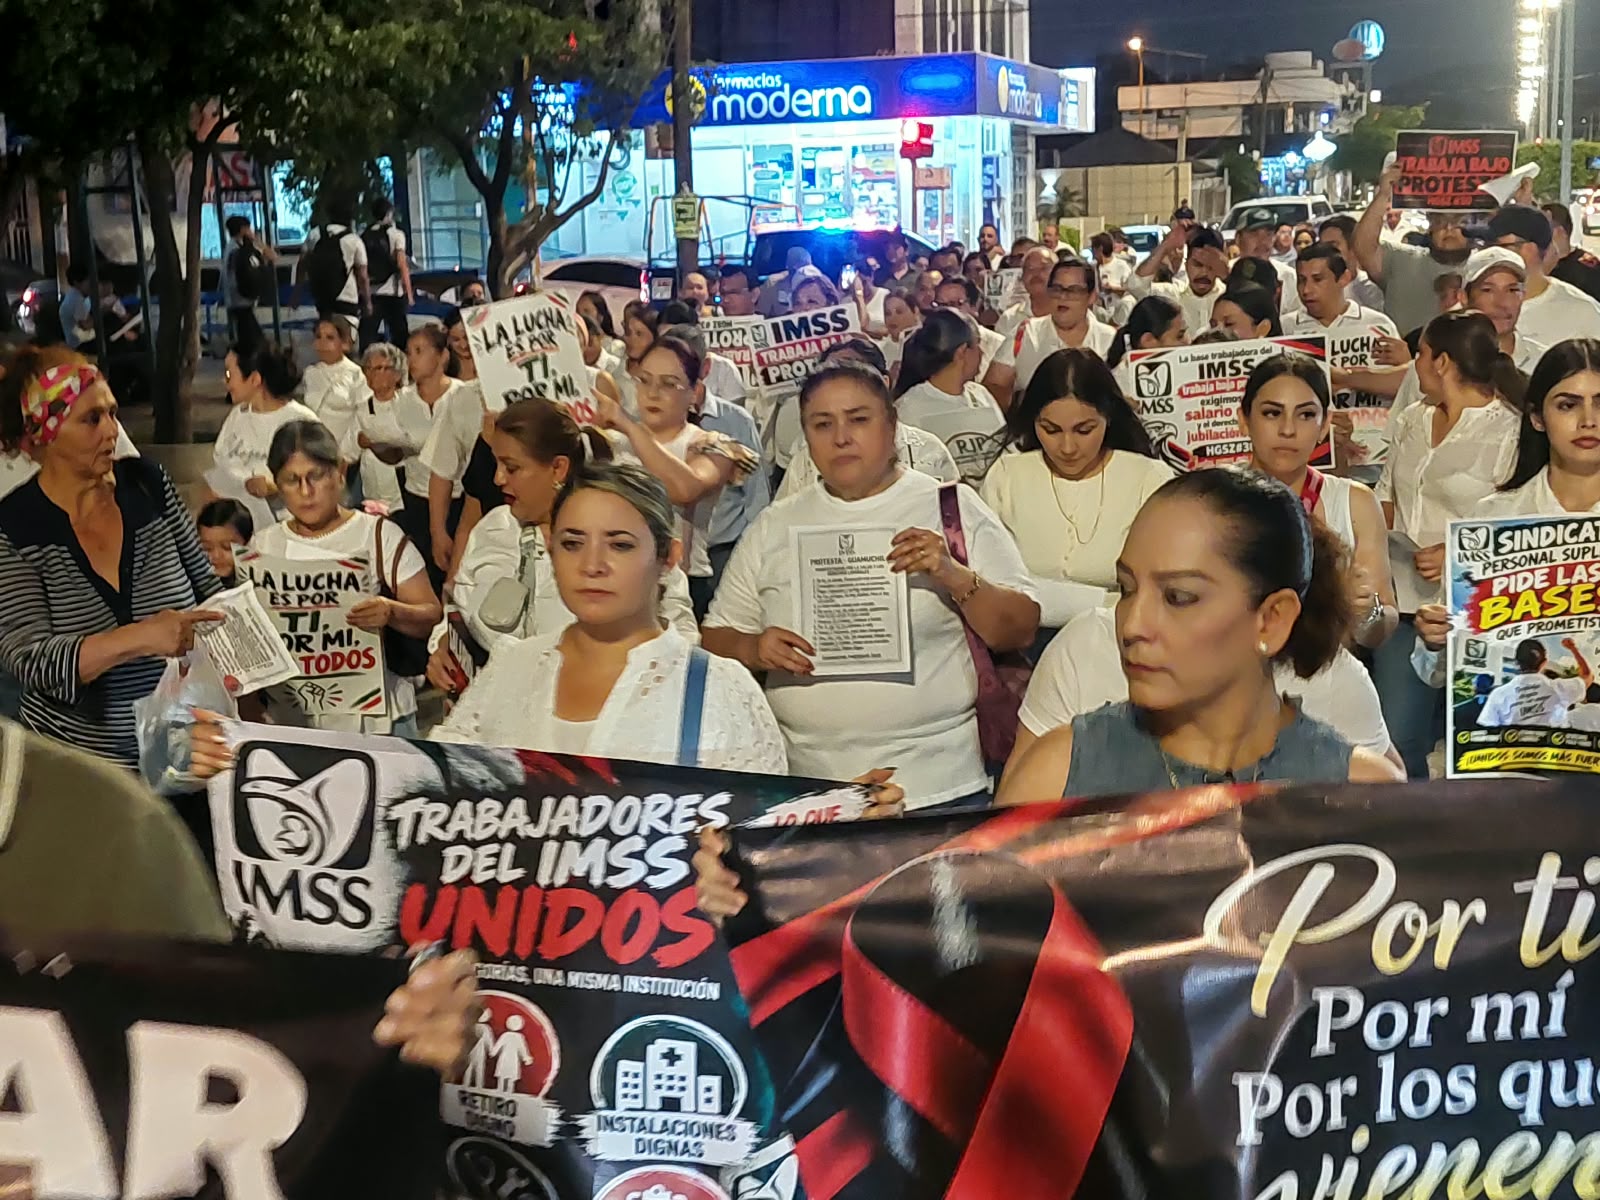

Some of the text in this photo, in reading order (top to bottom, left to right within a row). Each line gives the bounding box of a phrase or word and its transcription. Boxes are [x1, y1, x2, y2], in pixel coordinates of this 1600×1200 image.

[713, 84, 872, 121] moderna
[1401, 156, 1510, 173] TRABAJA BAJO
[1399, 175, 1491, 194] PROTEST
[481, 306, 568, 354] LA LUCHA
[771, 308, 850, 344] IMSS
[760, 340, 821, 365] TRABAJA
[1211, 347, 1258, 361] trabajadora
[1260, 344, 1273, 355] del
[1341, 353, 1369, 368] POR
[768, 358, 817, 385] PROT
[1199, 358, 1255, 380] IMSS
[1139, 398, 1174, 416] MSS
[1185, 405, 1233, 422] salario
[1482, 549, 1557, 576] PERSONAL
[248, 566, 361, 592] LA LUCHA
[1491, 562, 1600, 597] PIDE LAS
[270, 591, 340, 606] ES POR
[1479, 583, 1600, 630] BASE
[280, 632, 315, 653] OR
[1496, 624, 1523, 640] QUE
[299, 646, 377, 675] TODOS
[388, 791, 735, 850] TRABAJADORES
[440, 834, 692, 890] DEL IMSS
[232, 859, 373, 930] IMSS
[400, 883, 717, 969] UNIDOS
[1103, 843, 1487, 1018] Por
[533, 967, 566, 986] UNA
[567, 970, 622, 993] MISMA
[622, 974, 721, 1001] INSTITUCIÓN
[1311, 968, 1575, 1058] Por mí
[1232, 1052, 1600, 1147] Por los qu
[597, 1110, 737, 1141] INSTALACIONES
[634, 1138, 705, 1158] DIGNAS
